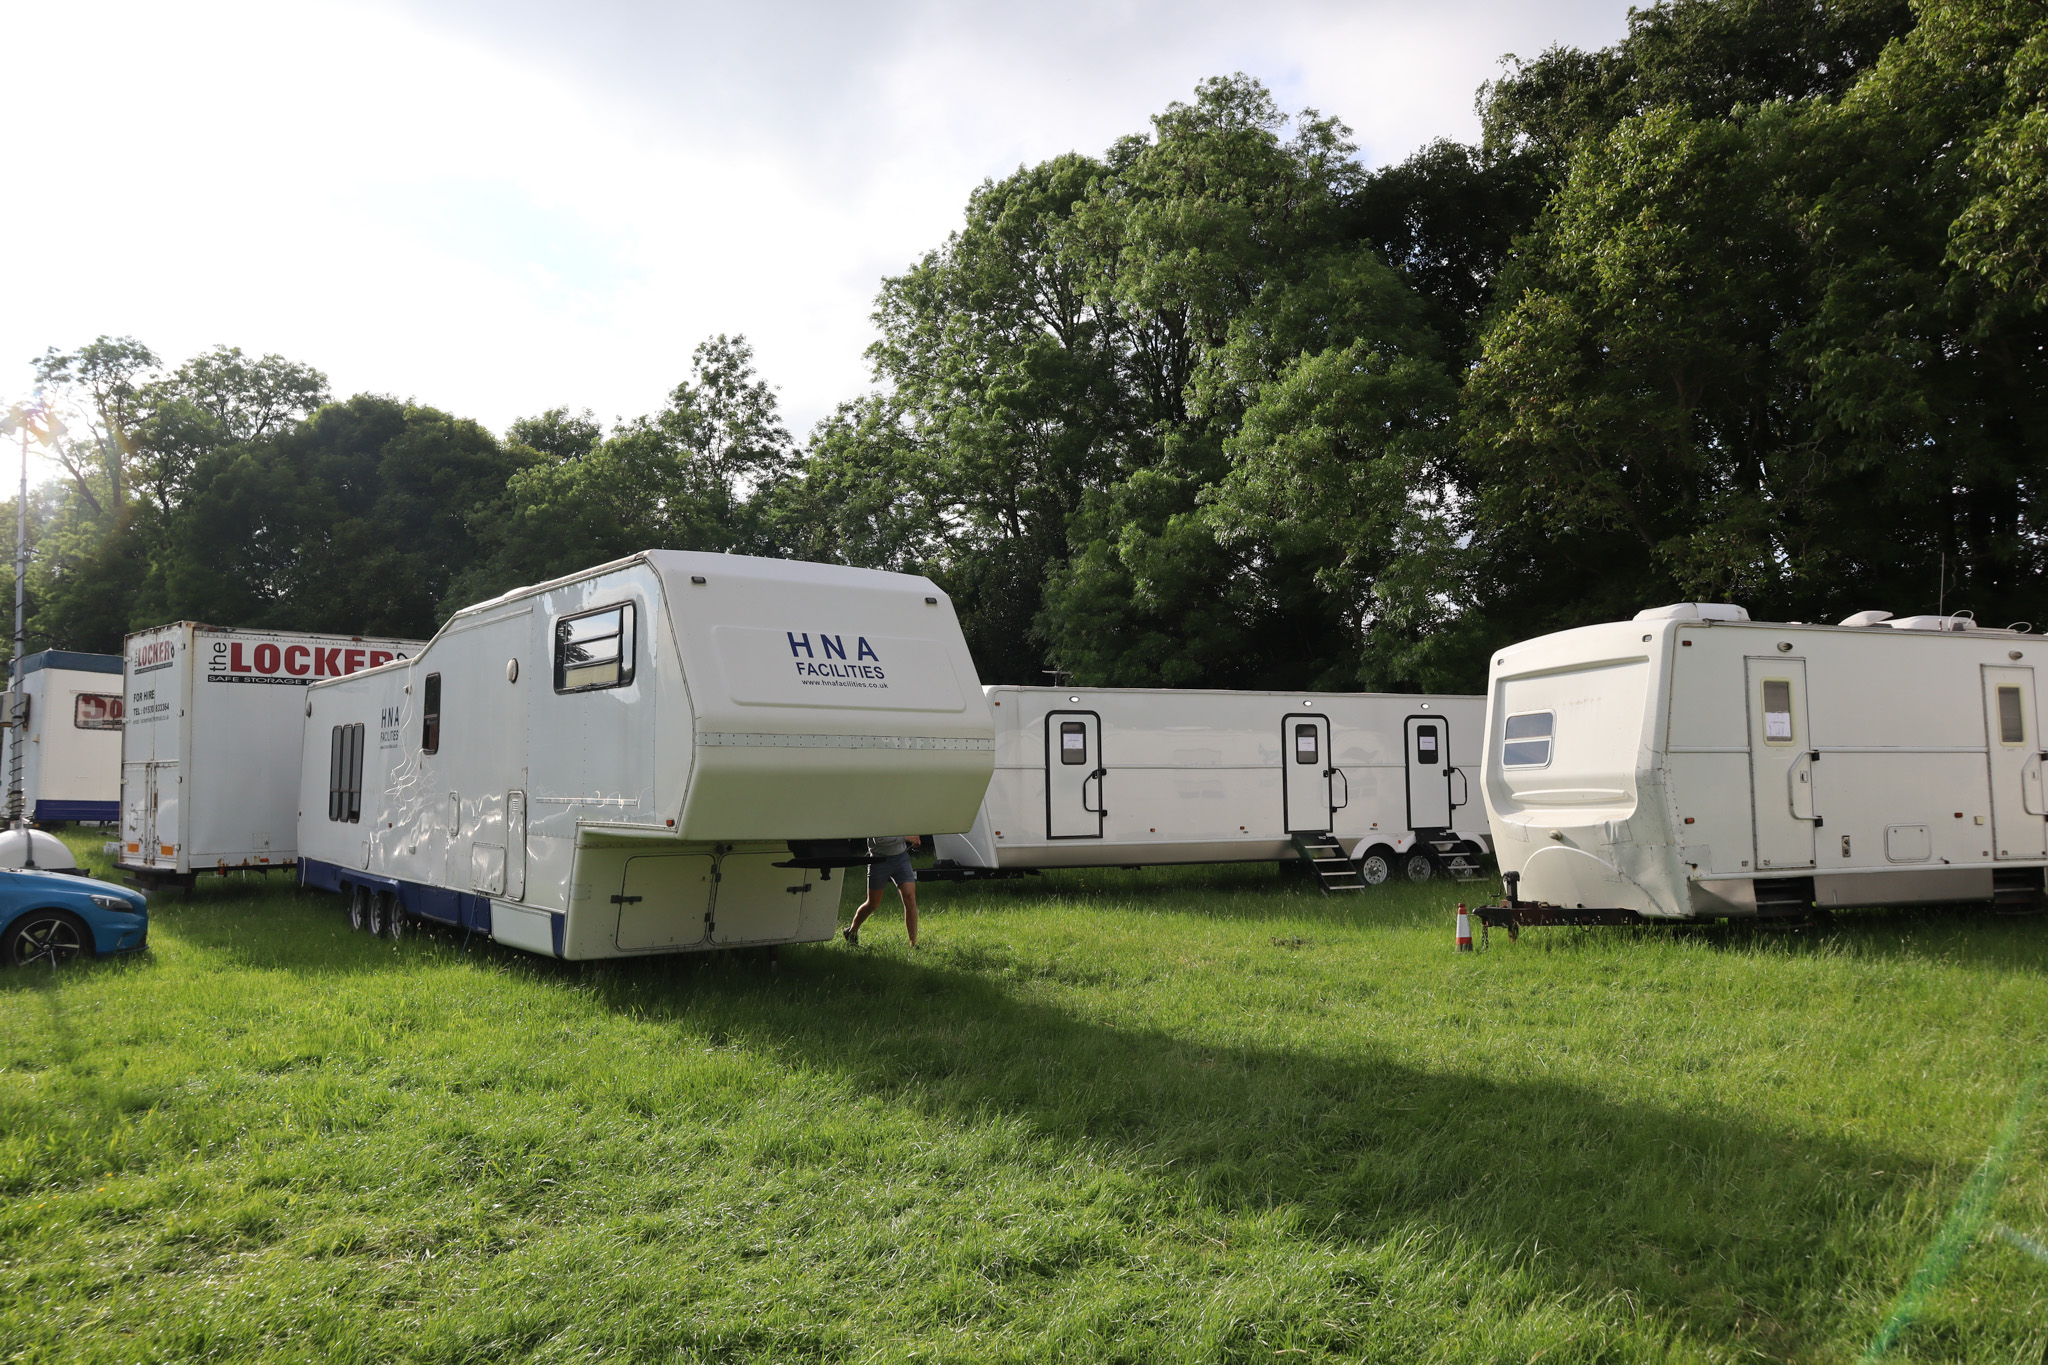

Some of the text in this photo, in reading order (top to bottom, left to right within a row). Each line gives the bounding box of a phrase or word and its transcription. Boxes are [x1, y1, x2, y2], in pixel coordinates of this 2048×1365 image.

[137, 640, 170, 667] LOCKER
[208, 642, 227, 672] the
[796, 662, 885, 679] FACILITIES
[243, 677, 300, 685] STORAGE
[801, 680, 889, 689] www.hnafacilities.co.uk
[133, 689, 155, 703] FOR HIRE
